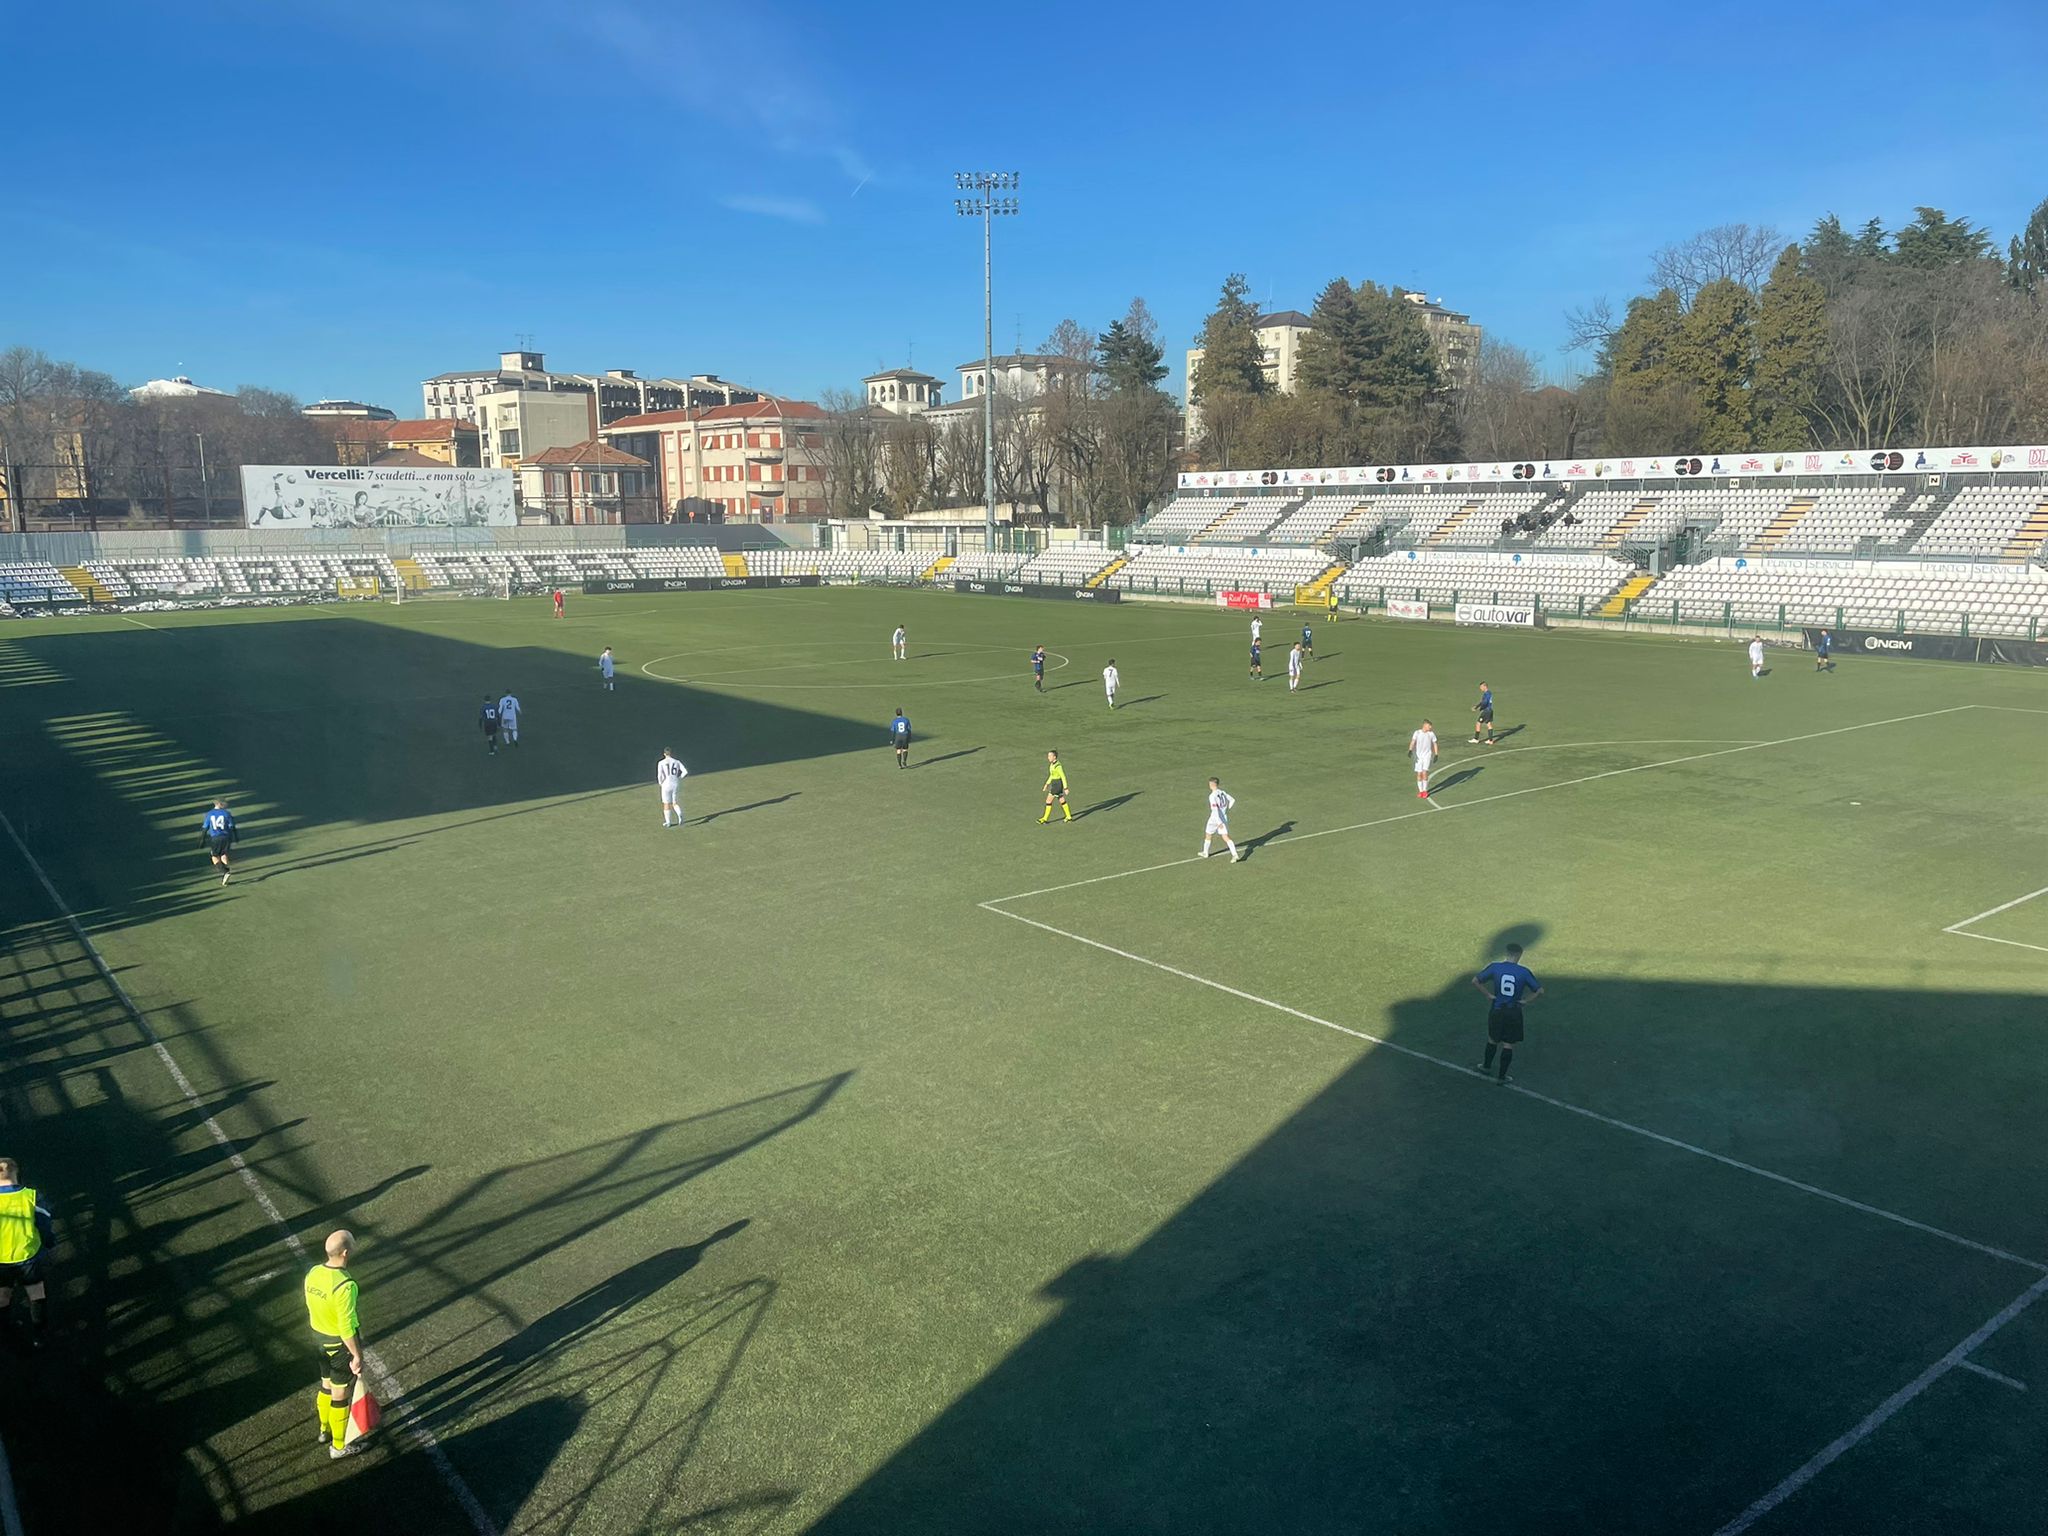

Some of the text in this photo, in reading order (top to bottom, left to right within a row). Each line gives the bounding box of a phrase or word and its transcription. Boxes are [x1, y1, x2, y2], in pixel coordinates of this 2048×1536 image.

[304, 469, 365, 480] Vercelli:
[367, 470, 374, 480] 7
[454, 471, 475, 481] solo
[1767, 560, 1853, 569] PUNTO SERVICE
[1926, 563, 2026, 574] PUNTO SERVICE
[1473, 607, 1531, 624] auto.var
[1877, 639, 1913, 650] NGM
[1108, 669, 1114, 678] 7
[505, 699, 512, 710] 2
[485, 709, 495, 719] 10
[898, 721, 905, 733] 8
[665, 763, 678, 776] 16
[210, 815, 224, 830] 14
[1500, 974, 1516, 997] 6
